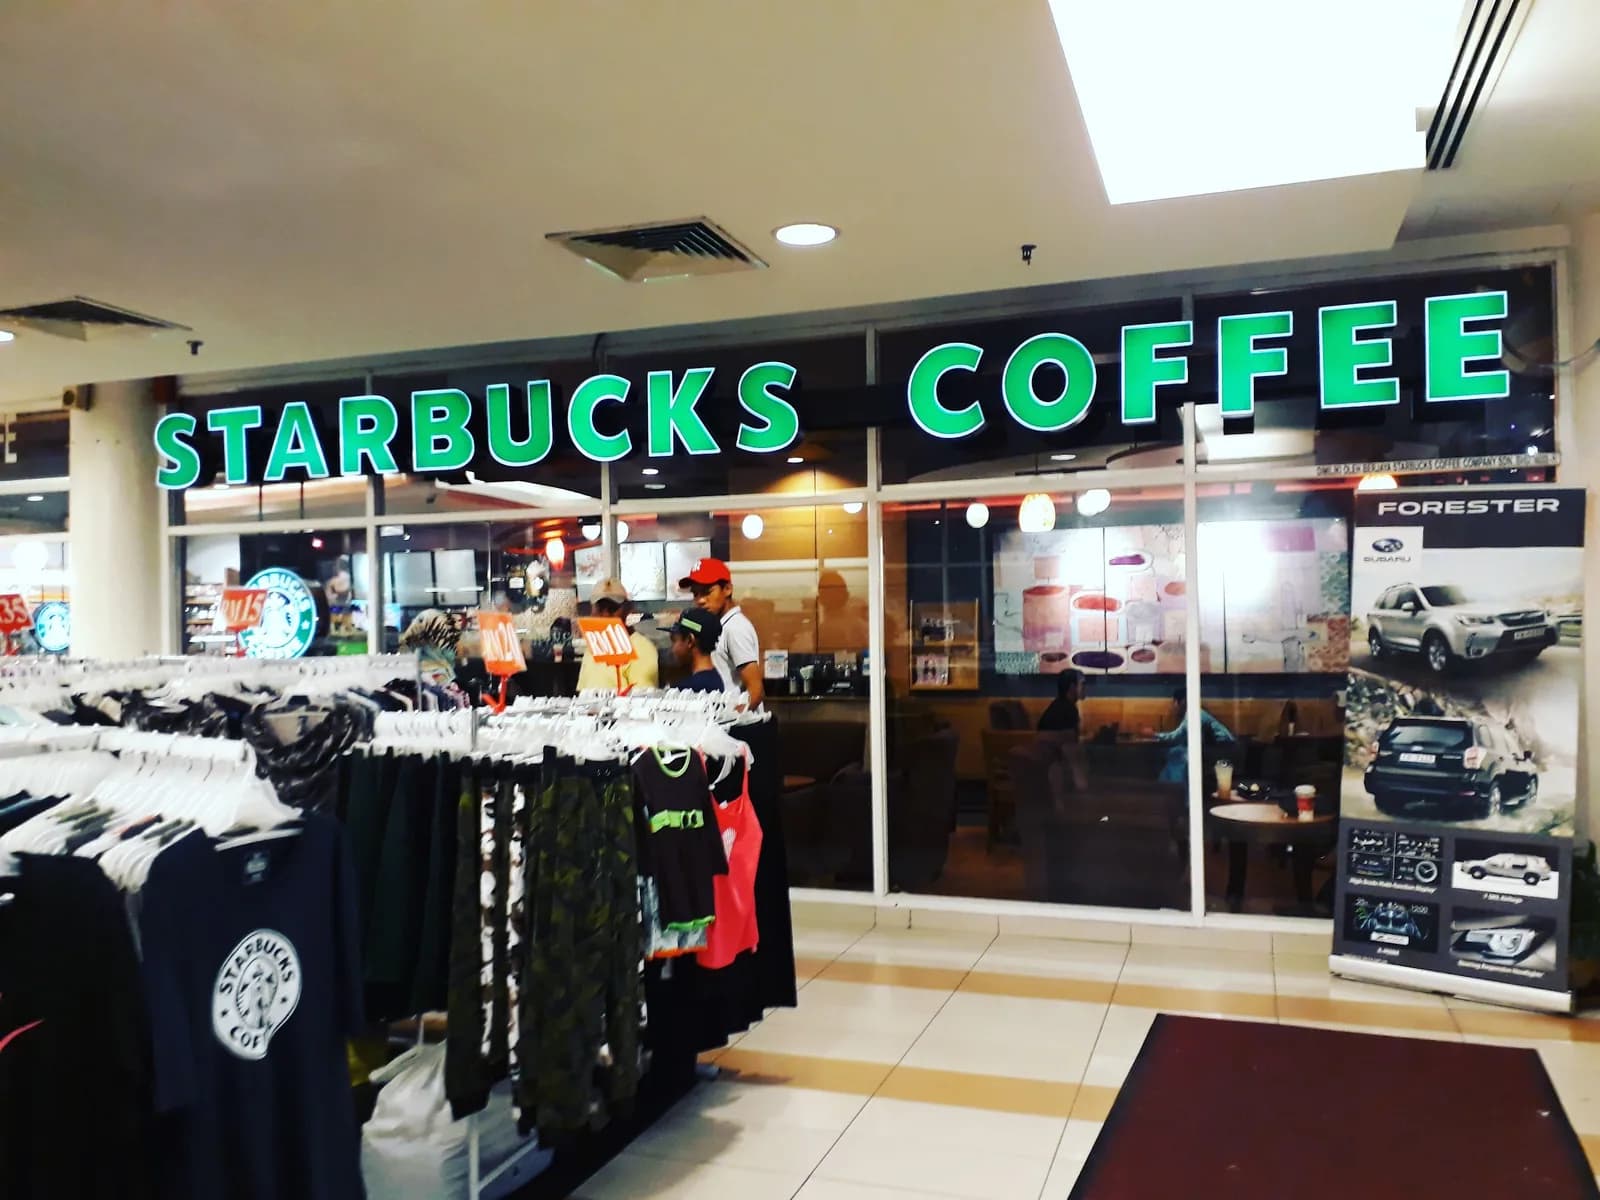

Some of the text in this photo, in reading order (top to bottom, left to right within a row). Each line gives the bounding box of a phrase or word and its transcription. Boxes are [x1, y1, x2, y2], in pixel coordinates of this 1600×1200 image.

[154, 291, 1510, 489] STARBUCKS COFFEE
[1393, 460, 1432, 472] STARBUCKS
[1434, 458, 1460, 470] COFFEE
[1378, 498, 1560, 516] FORESTER
[585, 623, 632, 656] RM10
[220, 938, 295, 994] STARBUCKS
